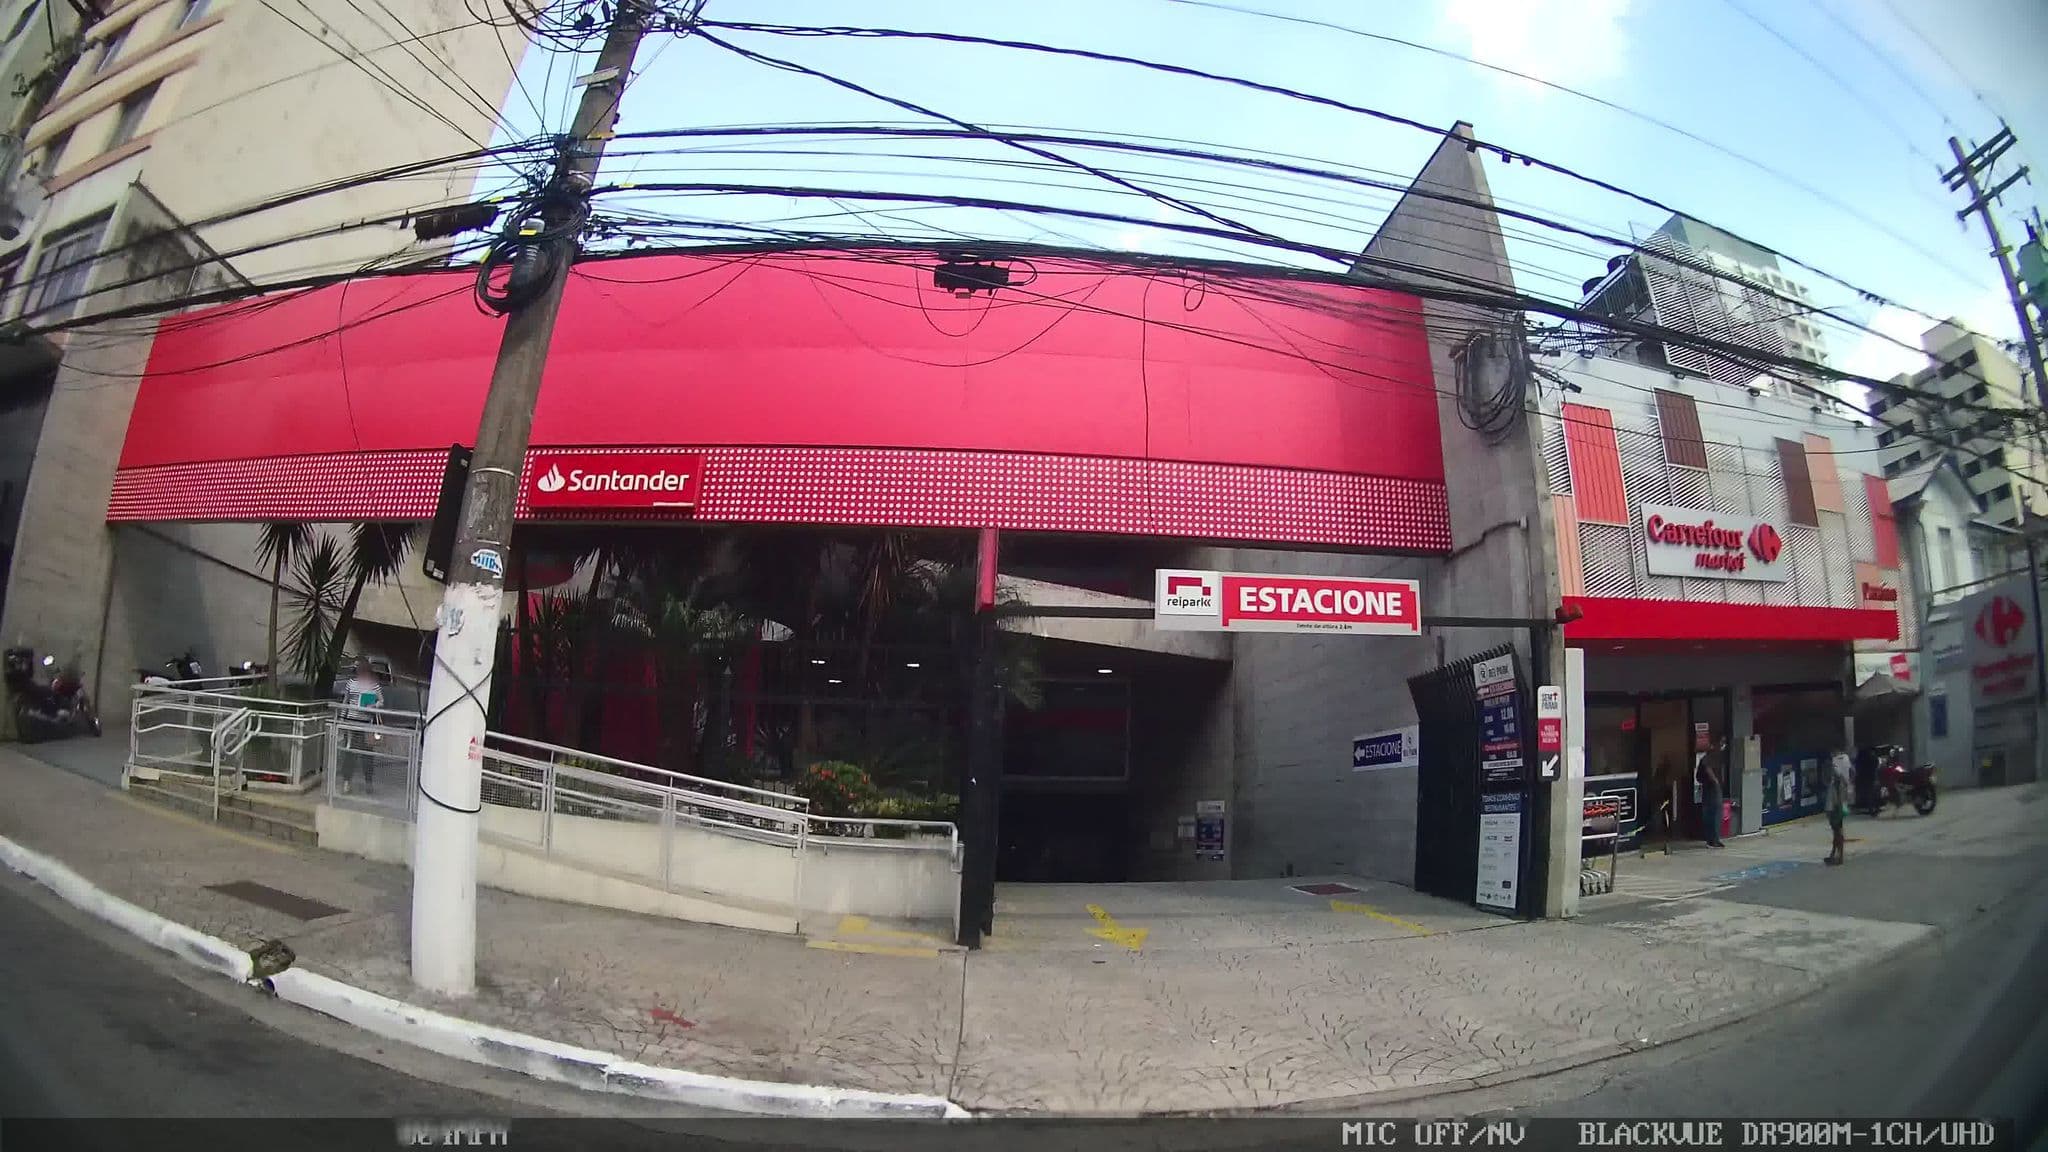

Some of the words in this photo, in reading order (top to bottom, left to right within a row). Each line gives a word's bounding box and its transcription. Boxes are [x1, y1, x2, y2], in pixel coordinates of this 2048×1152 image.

[567, 470, 689, 491] Santander
[1647, 514, 1744, 549] Carrefour
[1695, 552, 1746, 573] market
[1239, 586, 1403, 616] ESTACIONE
[1365, 740, 1402, 759] ESTACIONE
